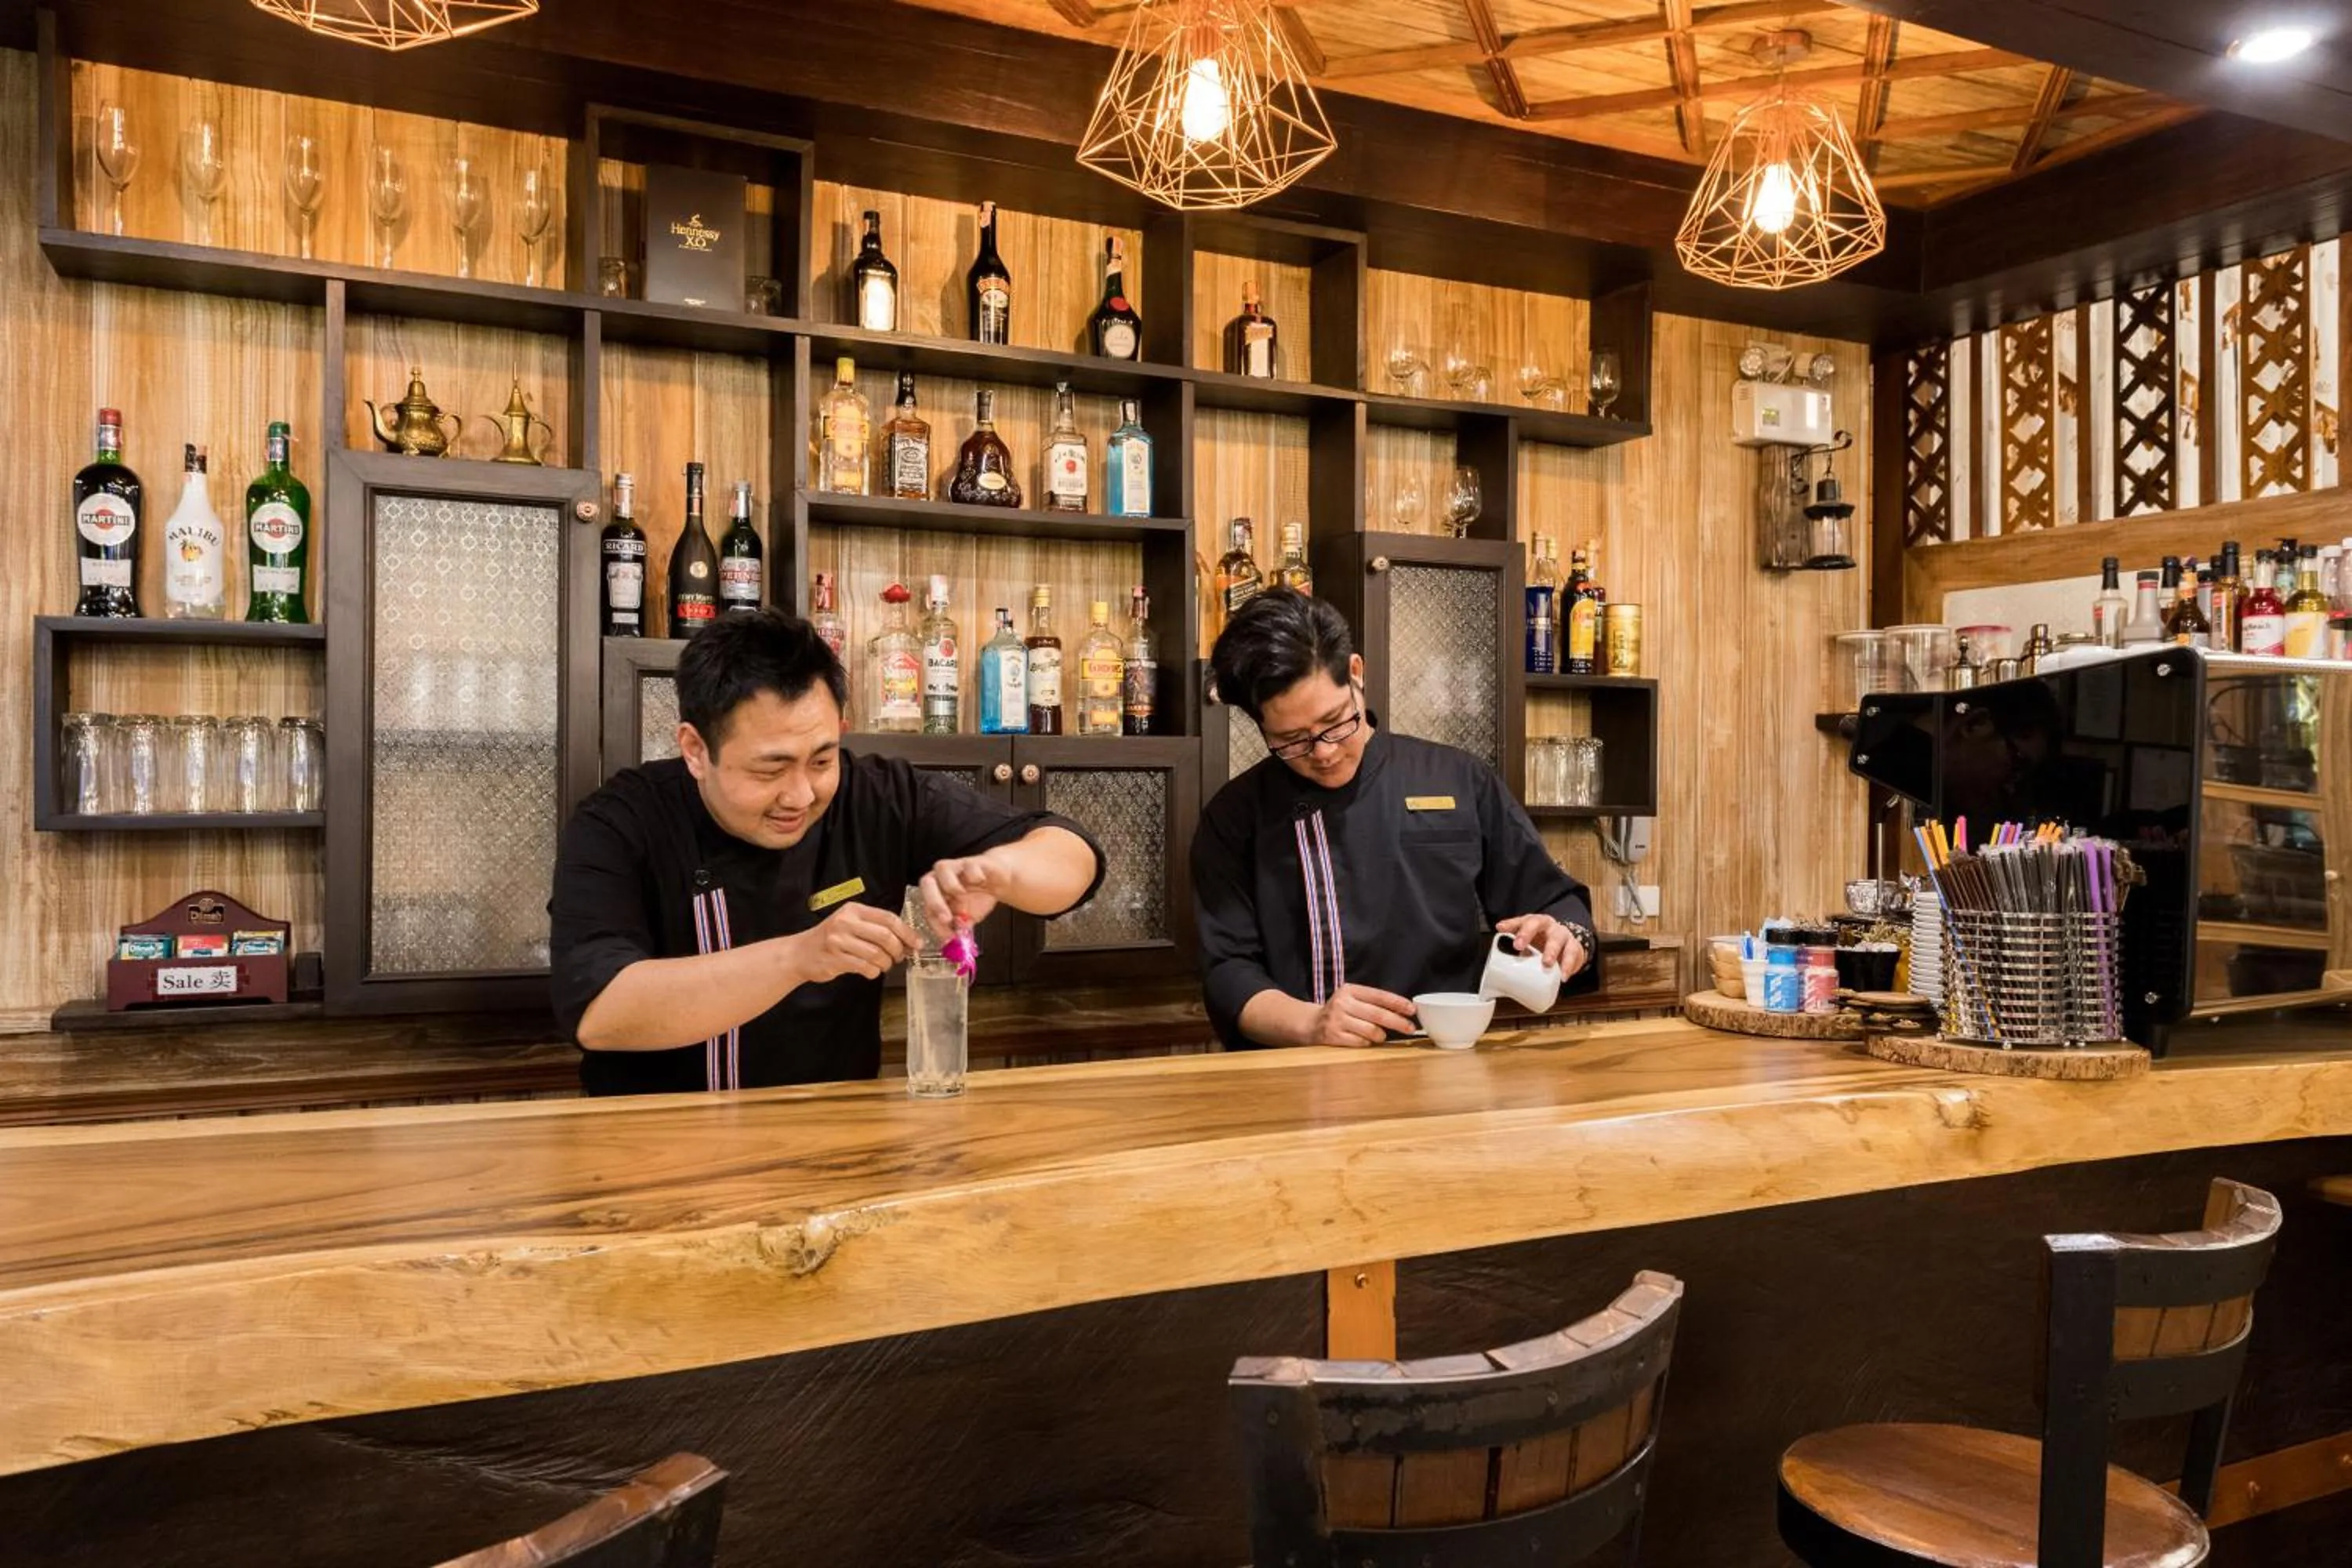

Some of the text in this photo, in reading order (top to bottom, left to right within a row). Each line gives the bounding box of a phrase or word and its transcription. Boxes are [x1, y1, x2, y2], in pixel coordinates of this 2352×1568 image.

[670, 221, 720, 241] Hennessy
[82, 514, 129, 526] MARTINI
[253, 522, 300, 535] MARTINI
[169, 526, 220, 546] MALIBU
[604, 541, 644, 552] RICARD
[162, 975, 203, 989] Sale
